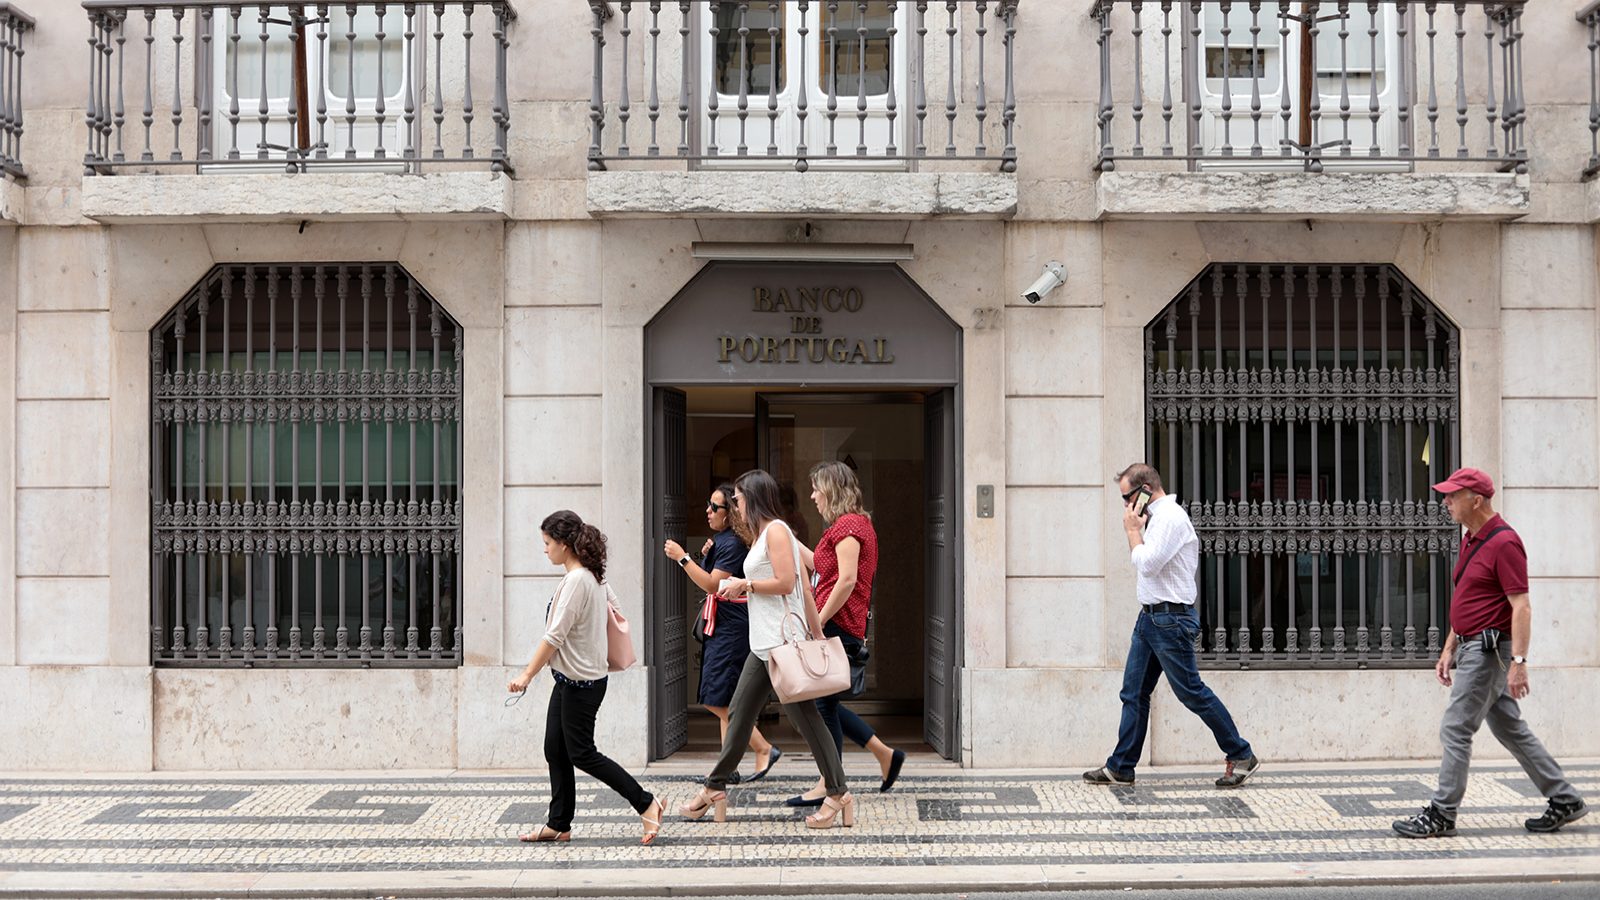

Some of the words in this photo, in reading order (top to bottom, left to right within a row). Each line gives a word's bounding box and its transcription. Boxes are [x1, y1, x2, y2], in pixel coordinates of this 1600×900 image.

[752, 286, 864, 313] BANCO
[791, 316, 822, 334] DE
[717, 336, 895, 364] PORTUGAL
